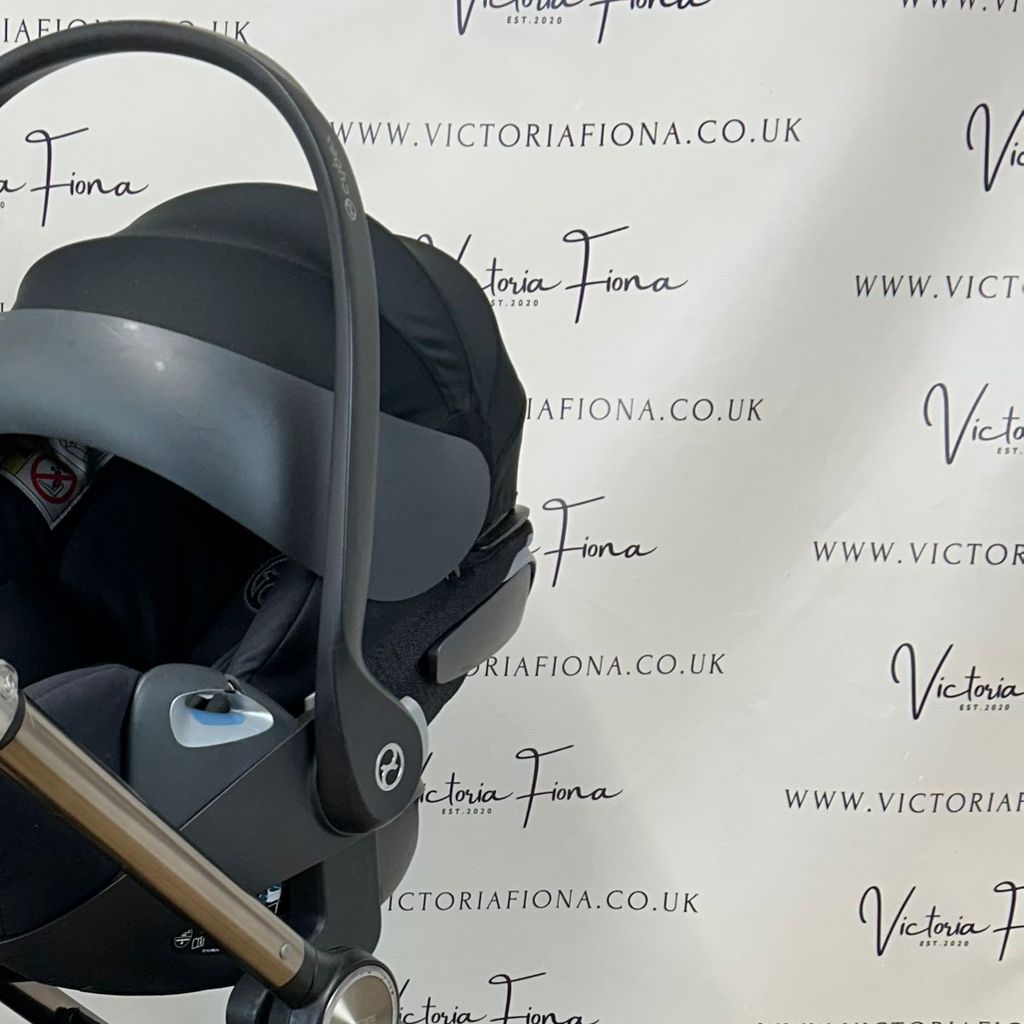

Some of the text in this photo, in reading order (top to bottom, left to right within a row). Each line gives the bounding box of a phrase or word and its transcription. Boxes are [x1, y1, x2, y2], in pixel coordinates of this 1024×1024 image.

[330, 117, 803, 148] WWW.VICTORIAFIONA.CO.UK
[25, 127, 149, 227] Fiona
[562, 226, 688, 323] Fiona
[542, 496, 658, 588] Fiona
[891, 642, 1024, 720] Victoria
[515, 745, 624, 828] Fiona
[859, 886, 991, 957] Victoria
